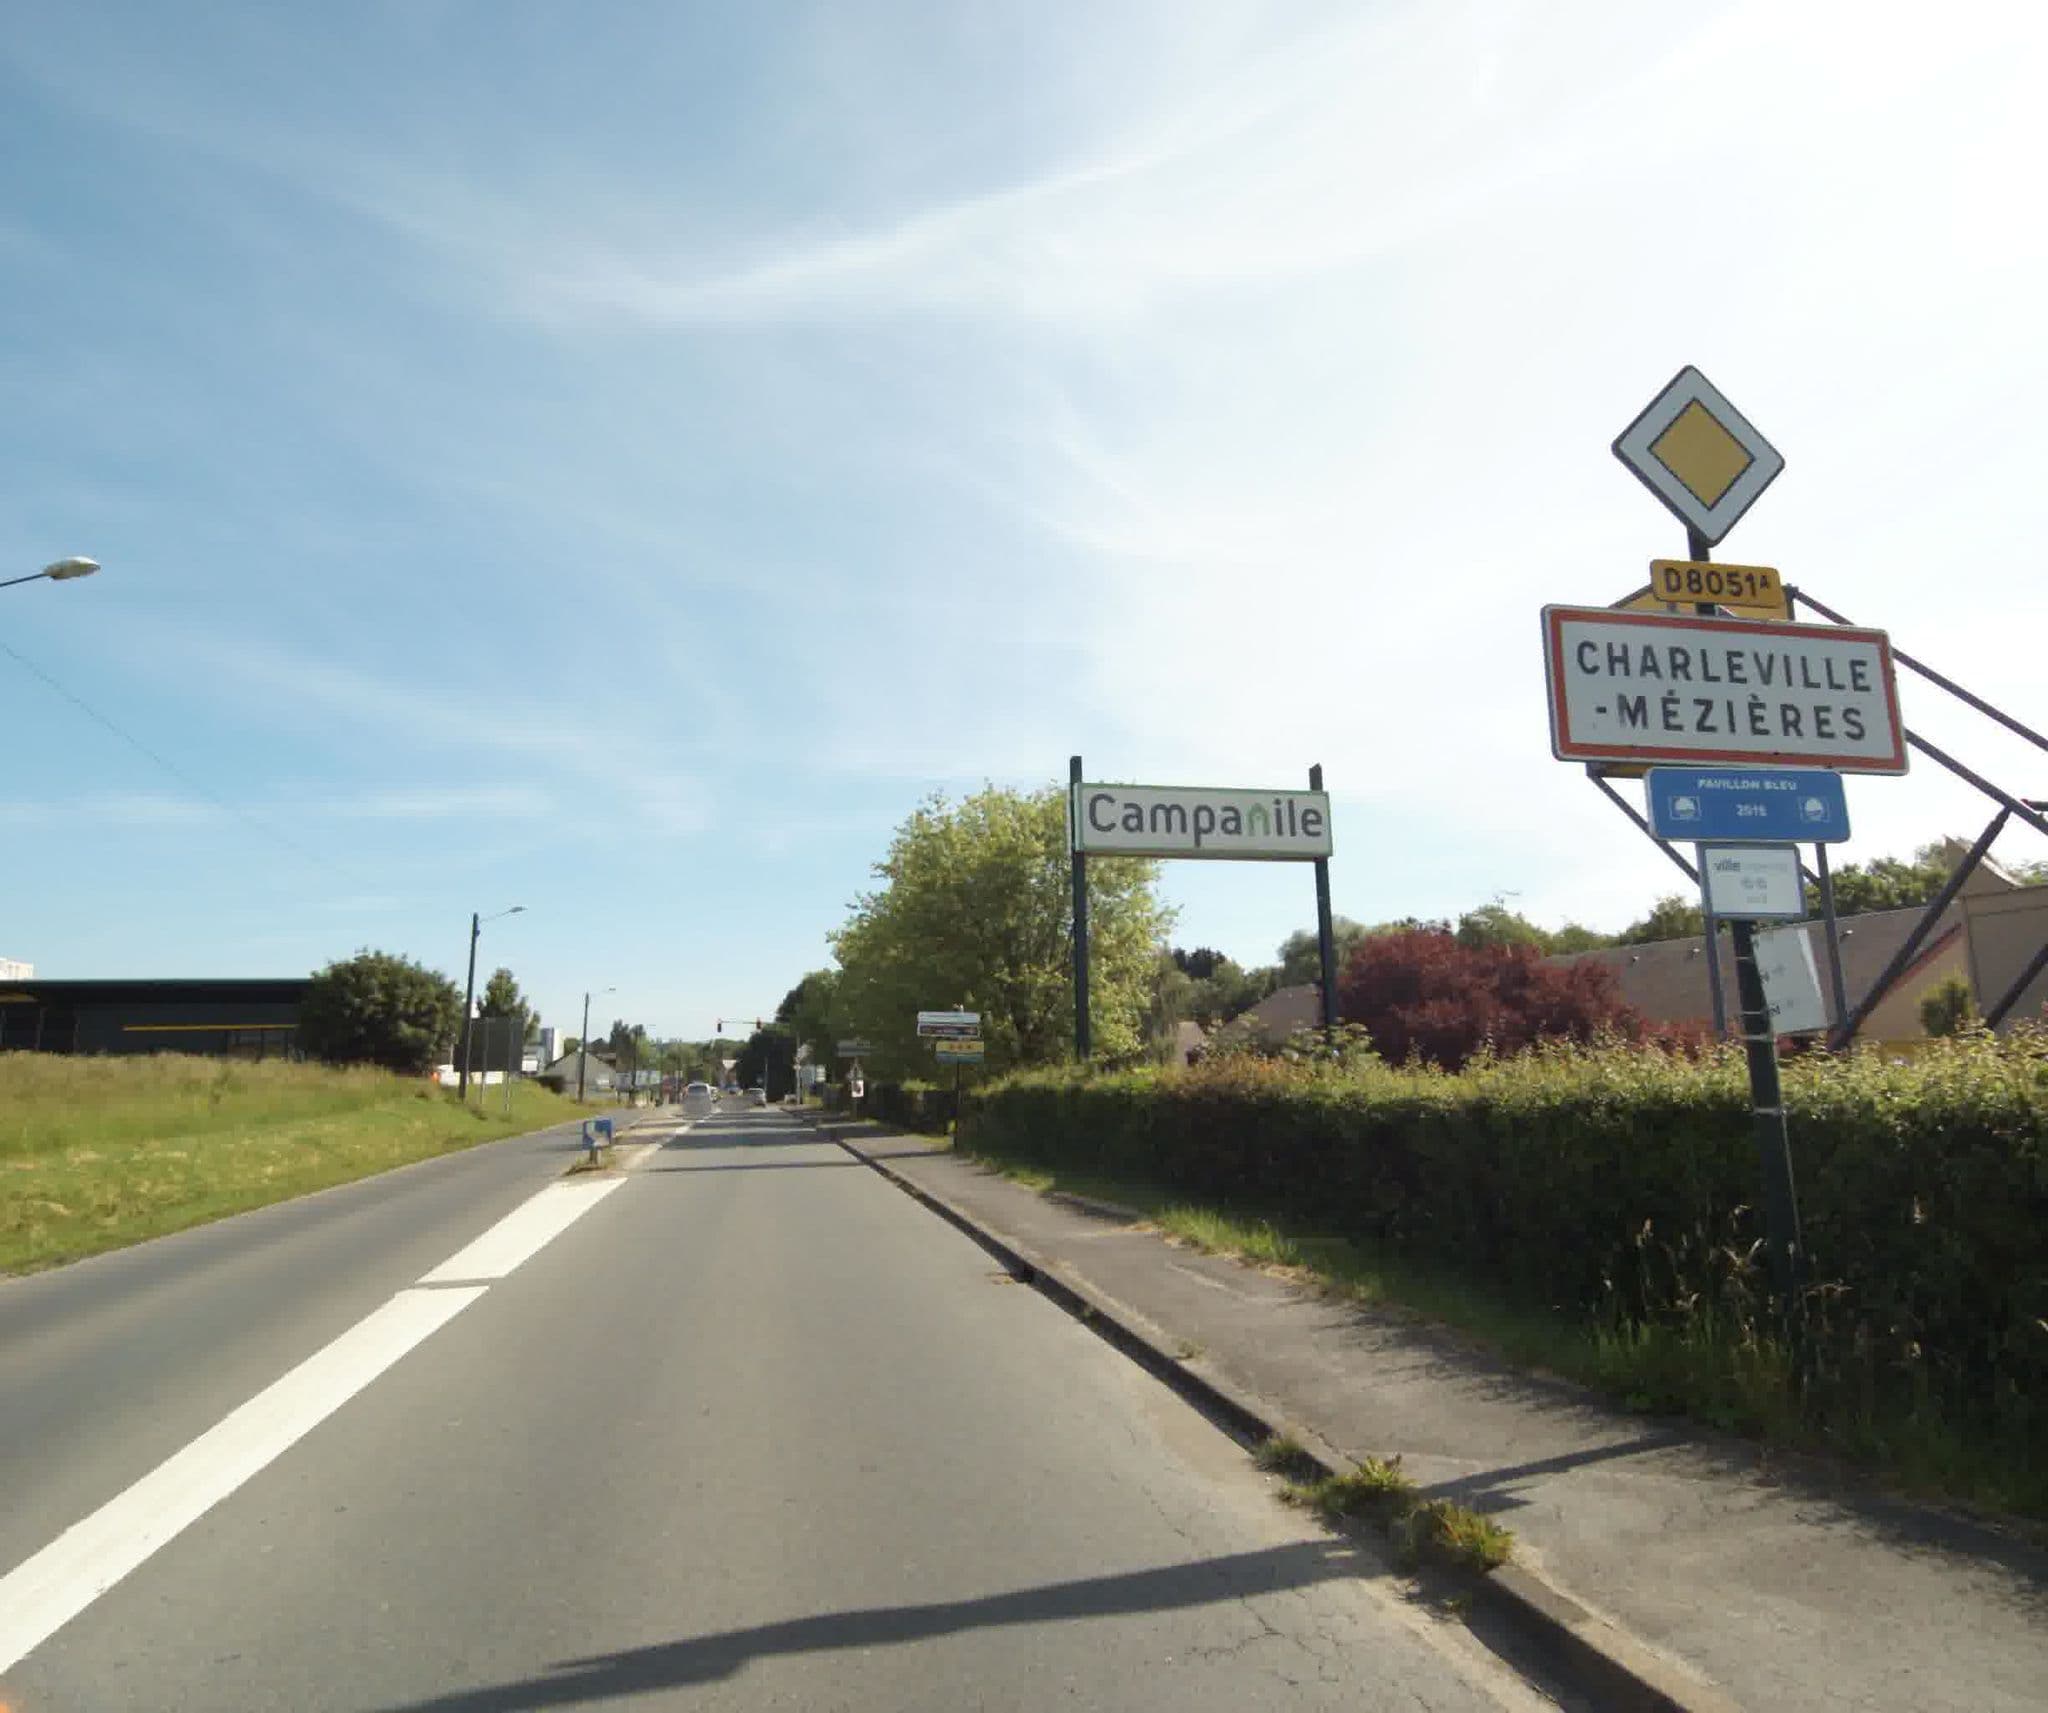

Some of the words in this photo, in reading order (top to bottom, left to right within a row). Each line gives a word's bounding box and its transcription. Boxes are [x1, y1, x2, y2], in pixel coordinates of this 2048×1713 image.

[1576, 640, 1871, 693] CHARLEVILLE
[1596, 689, 1866, 741] -MÉZIÈRES
[1698, 778, 1760, 790] PAVILLON
[1764, 779, 1797, 791] BLEU
[1088, 793, 1322, 848] Campanile
